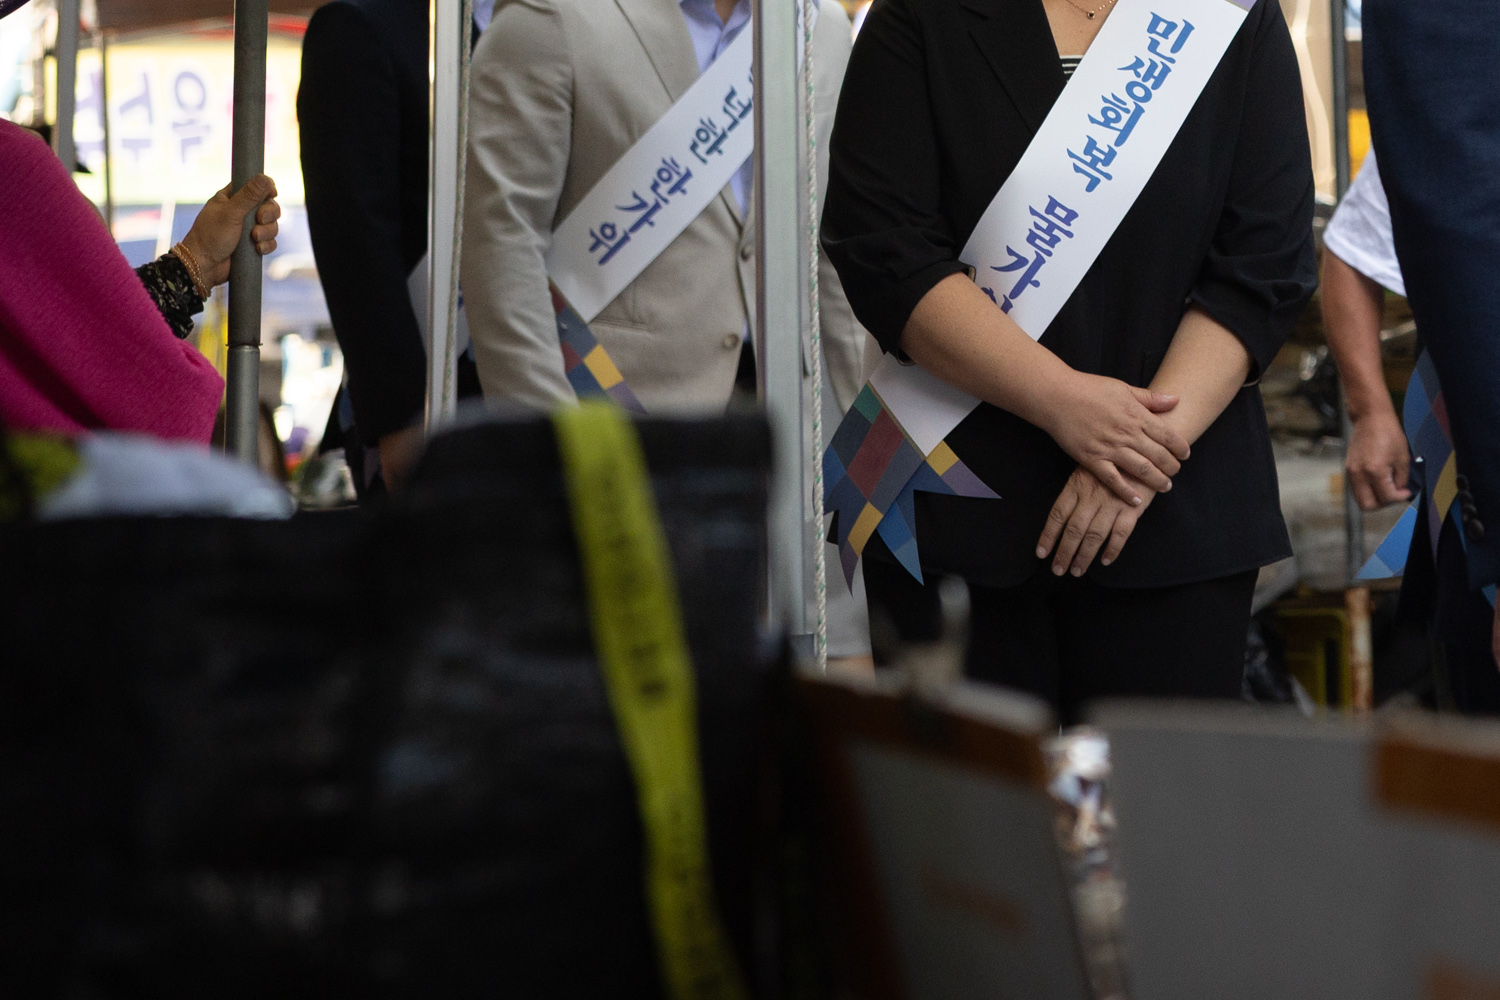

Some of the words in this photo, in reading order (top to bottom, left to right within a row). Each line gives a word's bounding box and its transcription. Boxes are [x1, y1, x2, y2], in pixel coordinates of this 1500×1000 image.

[688, 64, 753, 165] 넉한
[1066, 11, 1195, 195] 민생회복
[588, 155, 694, 266] 한가위
